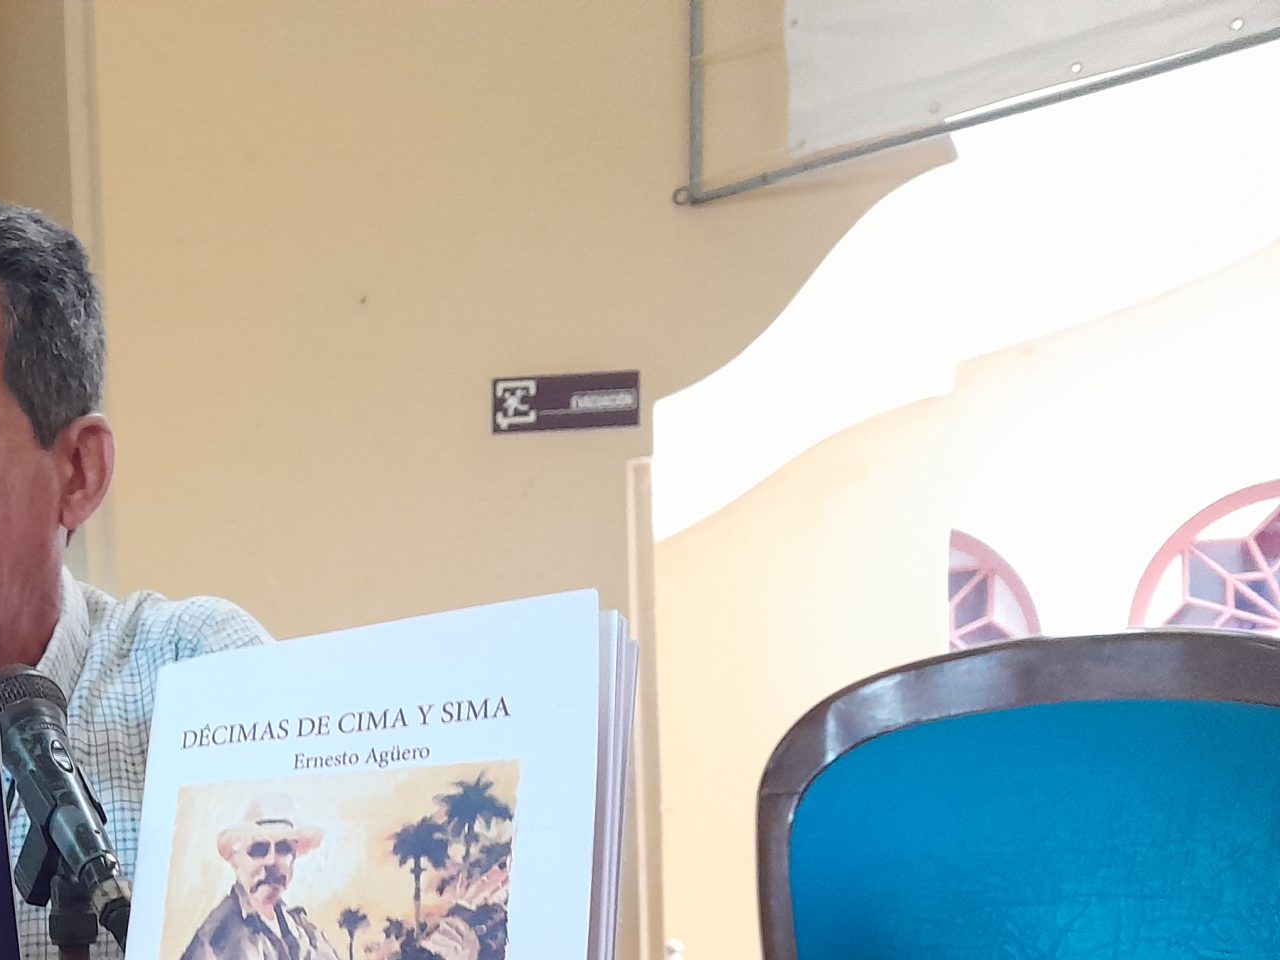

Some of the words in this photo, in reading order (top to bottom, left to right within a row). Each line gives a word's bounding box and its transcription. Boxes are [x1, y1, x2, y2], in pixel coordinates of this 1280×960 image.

[181, 719, 289, 750] DÉCIMAS
[296, 715, 331, 738] DE
[337, 706, 409, 734] CIMA
[417, 703, 434, 726] Y
[441, 695, 511, 724] SIMA
[293, 751, 360, 770] Ernesto
[364, 745, 431, 768] Agüero
